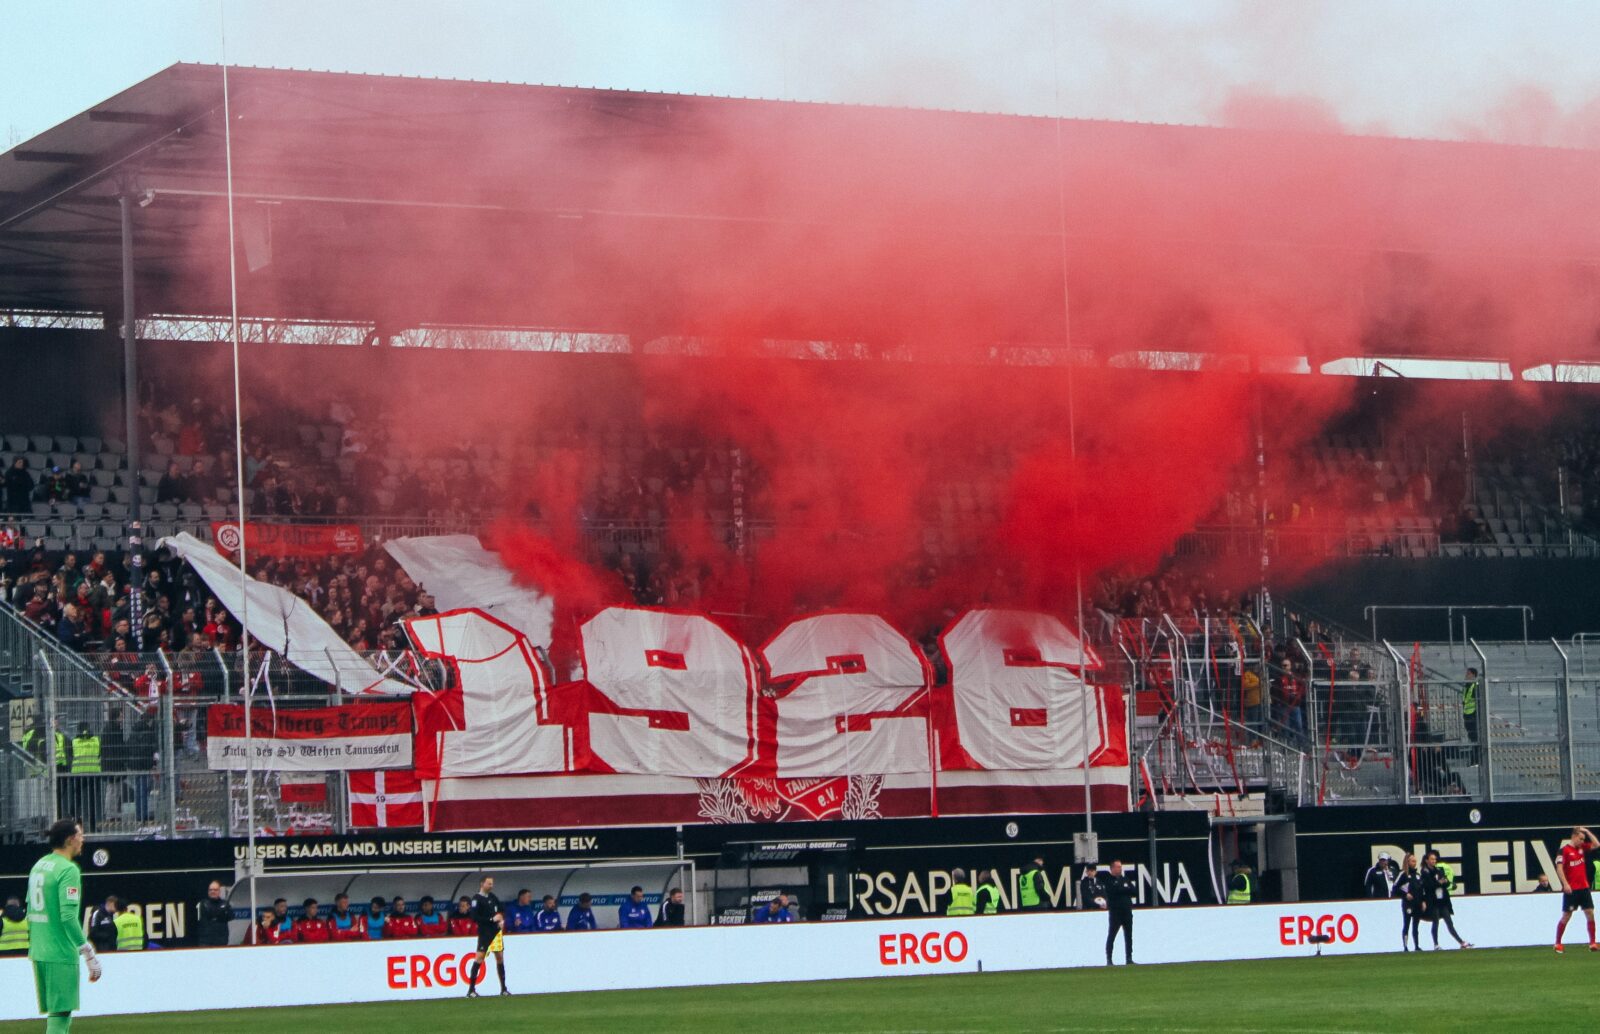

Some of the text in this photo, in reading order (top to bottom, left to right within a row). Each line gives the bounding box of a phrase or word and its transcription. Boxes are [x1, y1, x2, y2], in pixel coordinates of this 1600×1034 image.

[256, 745, 272, 757] des
[277, 745, 296, 757] SV
[300, 745, 341, 760] Wehen
[345, 742, 399, 756] Taunusstein
[817, 786, 839, 807] e.V.
[290, 842, 379, 858] SAARLAND.
[382, 840, 443, 856] UNSERE
[446, 839, 505, 854] HEIMAT.
[508, 837, 567, 852] UNSERE
[570, 836, 598, 850] ELV.
[1279, 913, 1359, 946] ERGO
[879, 930, 968, 966] ERGO
[387, 952, 487, 989] ERGO
